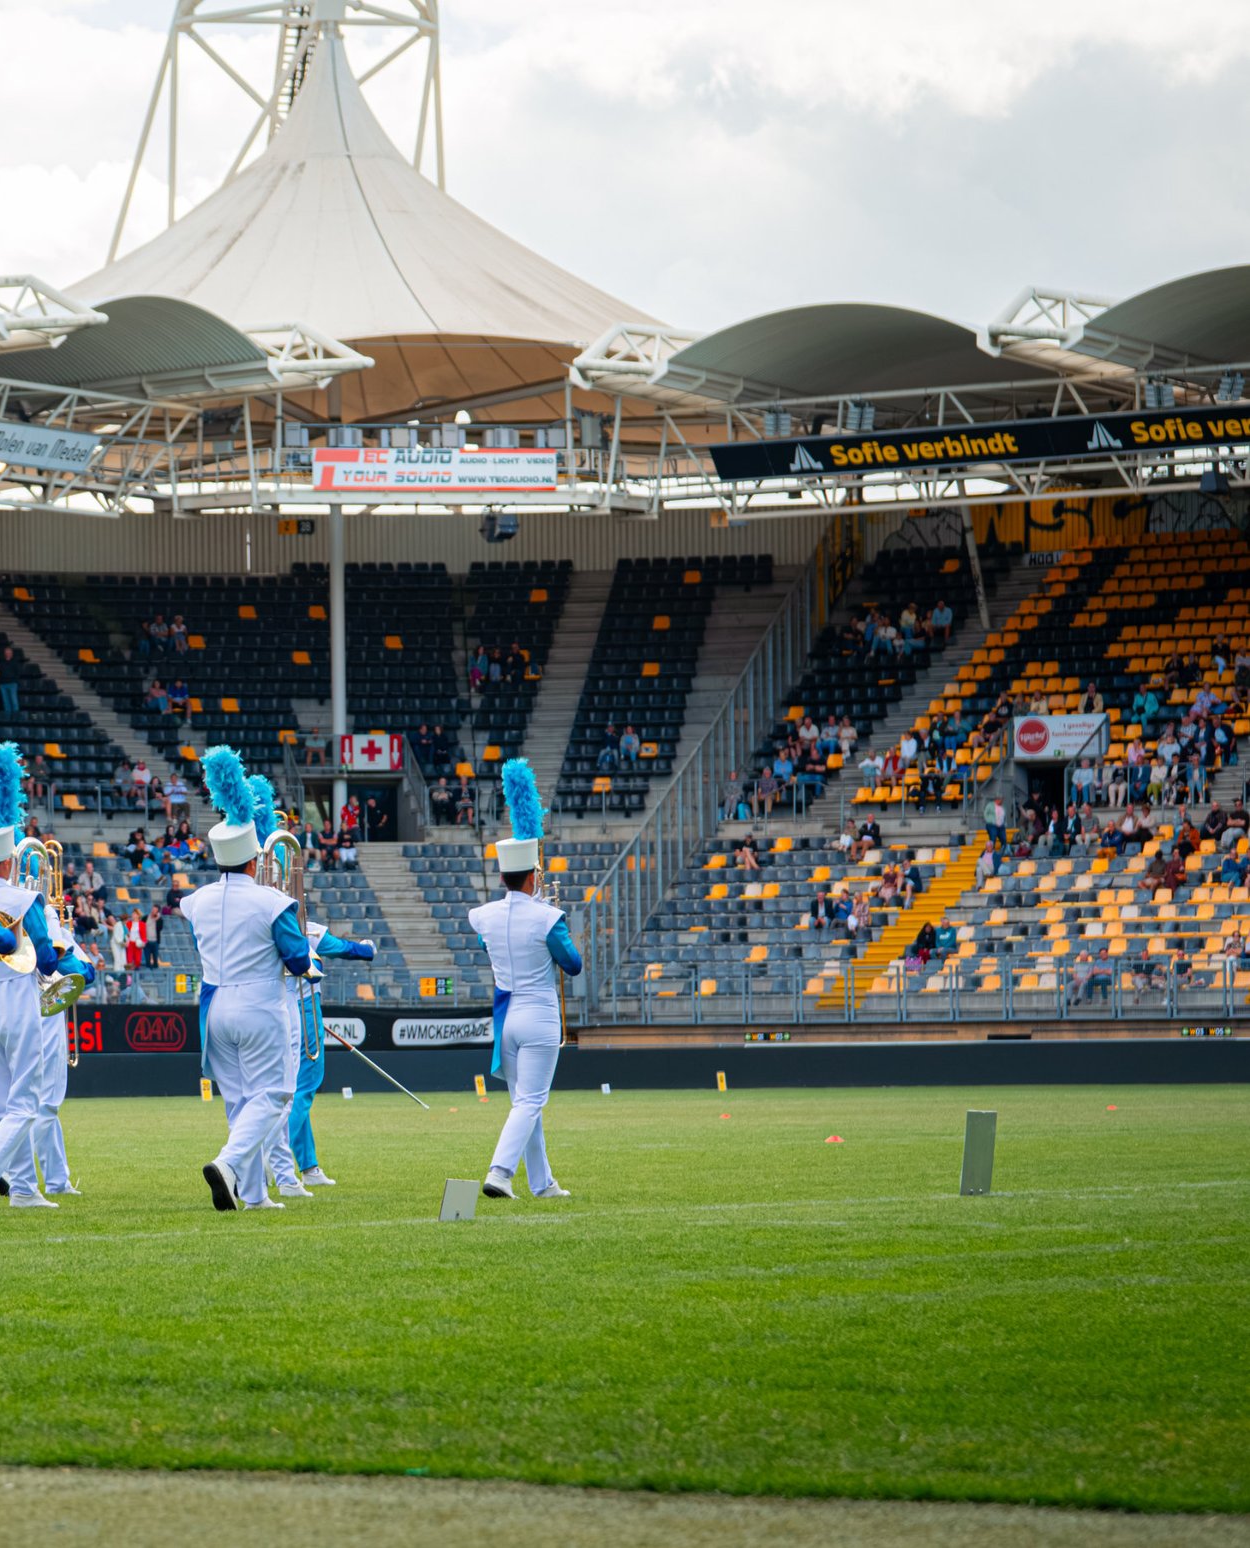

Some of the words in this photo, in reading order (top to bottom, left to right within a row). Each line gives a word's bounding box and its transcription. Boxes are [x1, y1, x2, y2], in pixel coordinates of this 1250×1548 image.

[1130, 417, 1204, 444] Sofie
[25, 441, 49, 457] van
[394, 449, 453, 464] AUDIO
[829, 440, 900, 467] Sofie
[902, 432, 1019, 461] verbindt
[343, 470, 388, 482] YOUR
[395, 471, 453, 483] SOUND
[133, 1015, 182, 1046] ADAMS
[399, 1022, 490, 1040] #WMCKERKRADE
